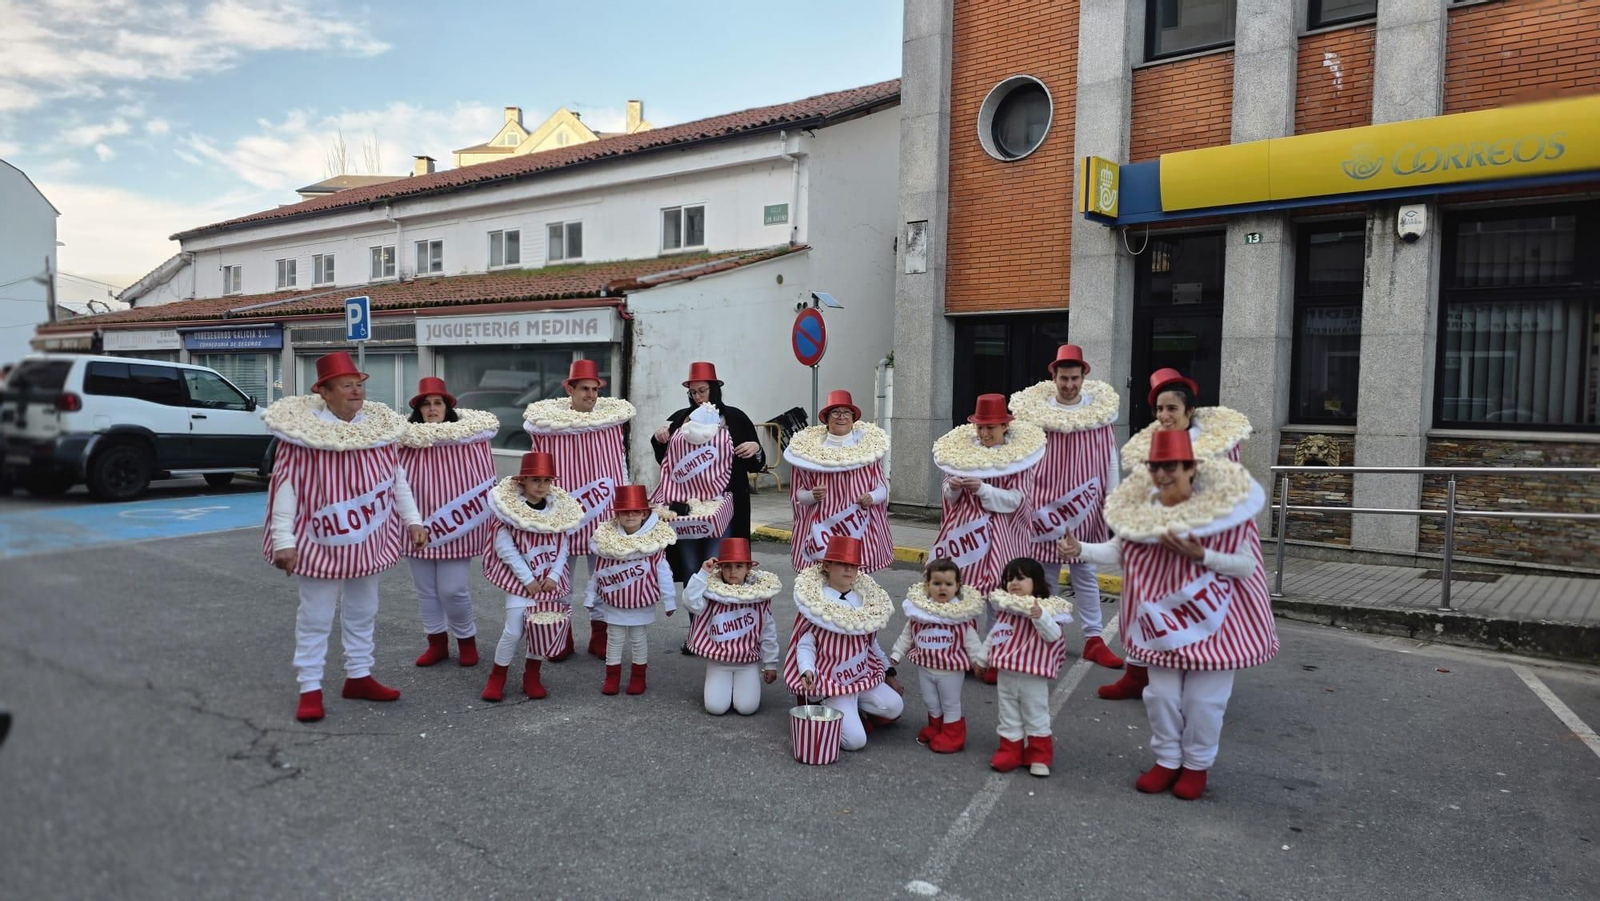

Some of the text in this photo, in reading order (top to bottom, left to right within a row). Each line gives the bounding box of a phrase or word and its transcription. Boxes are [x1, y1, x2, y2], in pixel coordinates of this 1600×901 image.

[1247, 233, 1260, 243] 13
[347, 303, 363, 337] P
[231, 330, 256, 339] GALICIA
[258, 329, 270, 338] S.L.
[426, 318, 598, 341] JUGUETERIA MEDINA
[917, 635, 954, 644] PALOMITAS
